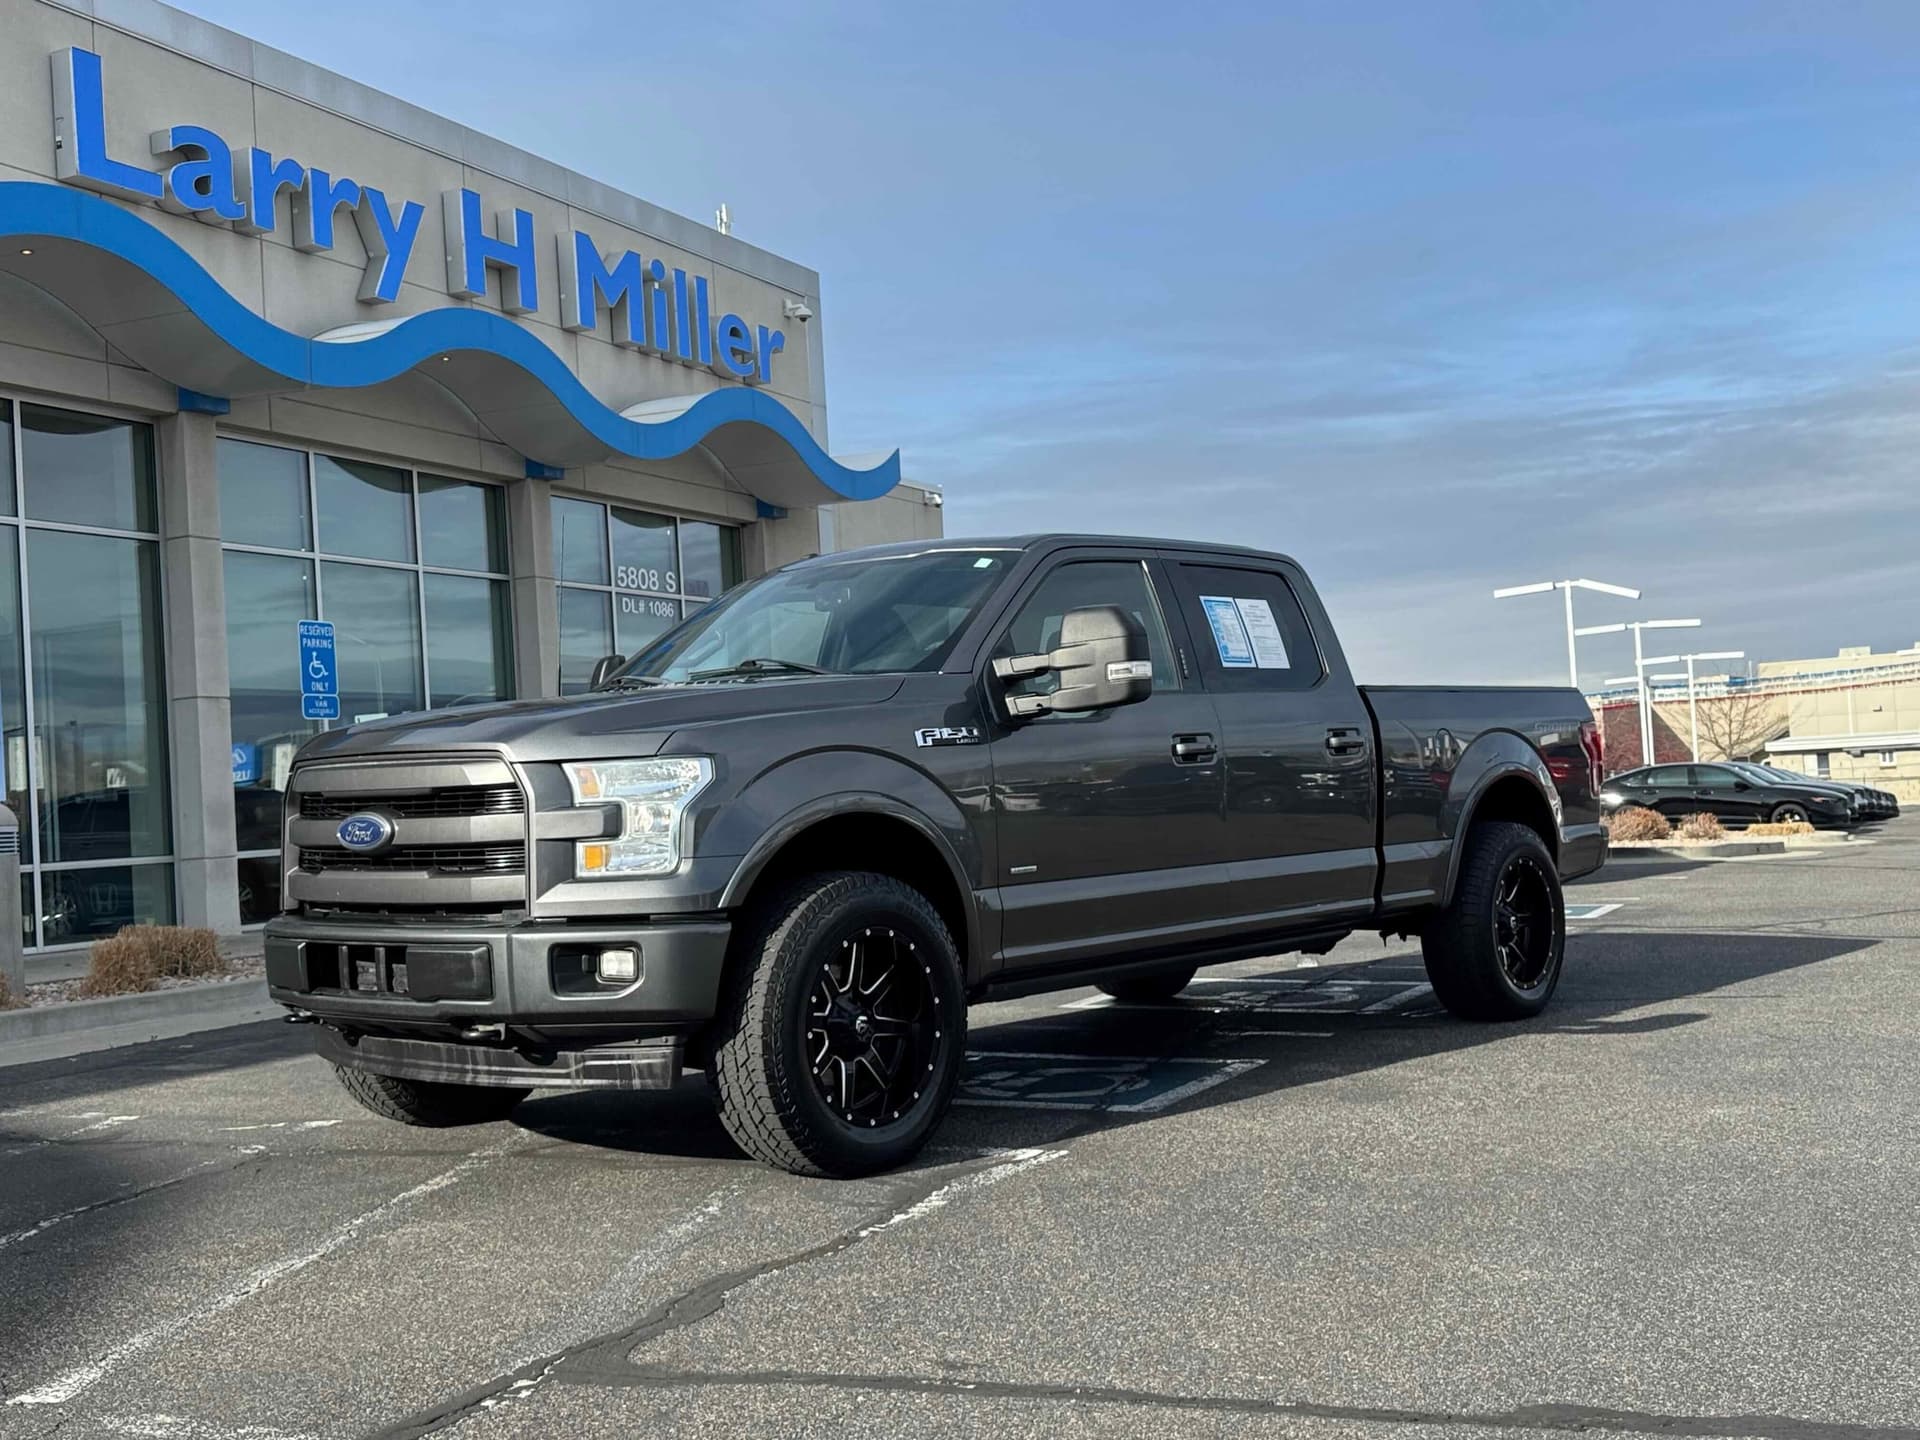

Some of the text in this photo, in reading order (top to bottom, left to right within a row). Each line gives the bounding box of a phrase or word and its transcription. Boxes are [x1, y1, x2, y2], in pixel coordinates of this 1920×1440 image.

[70, 47, 786, 384] Larry H Miller
[616, 566, 677, 592] 5808 S
[622, 597, 674, 617] DL# 1086
[300, 624, 333, 636] RESERVED
[303, 637, 332, 649] PARKING
[311, 681, 329, 692] ONLY
[314, 700, 328, 708] VAN
[345, 822, 375, 842] Ford
